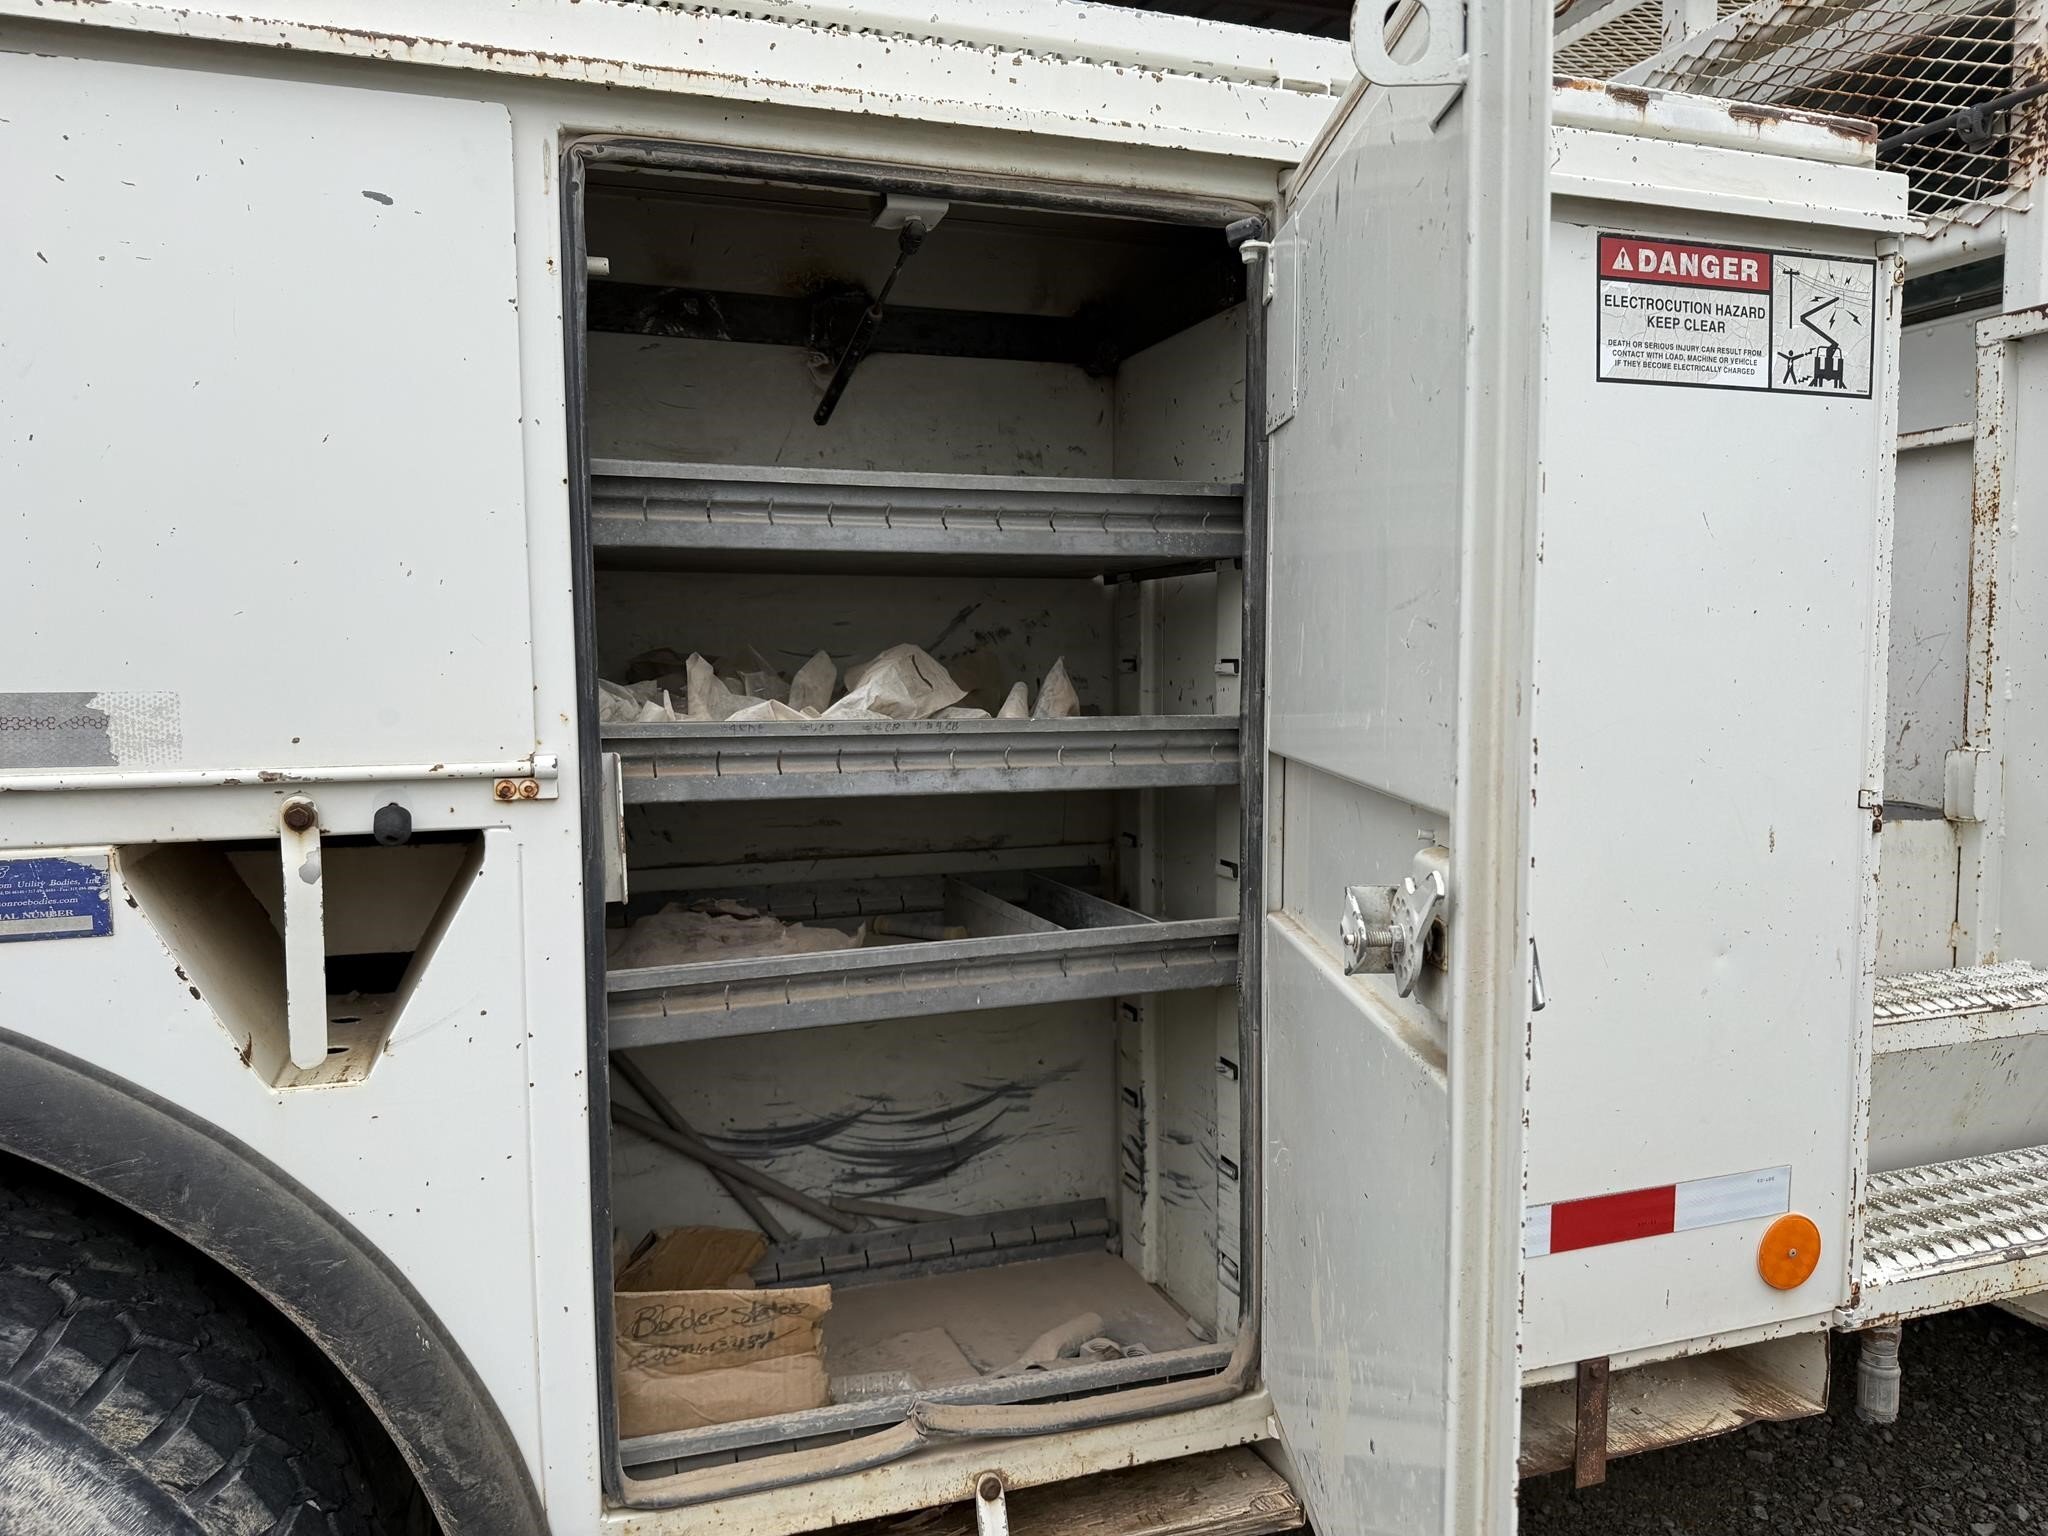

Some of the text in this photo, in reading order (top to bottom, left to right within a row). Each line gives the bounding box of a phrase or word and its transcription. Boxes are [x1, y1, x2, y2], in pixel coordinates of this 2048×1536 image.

[1638, 248, 1759, 282] DANGER
[1604, 294, 1766, 319] ELECTROCUTION HAZARD
[1647, 316, 1726, 333] KEEP CLEAR
[1607, 339, 1762, 357] DEATH OR SERIOUS INJURY CAN RESULT FROM
[1612, 349, 1758, 366] CONTACT WITH LOAD, MACHINE OR VEHICLE
[1614, 359, 1756, 375] IF THEY BECOME ELECTRICALLY CHARGED
[17, 880, 46, 889] Utility
[49, 878, 81, 887] Bodies,
[0, 897, 79, 908] onroebodies.com
[22, 909, 74, 919] NUMBER
[630, 1303, 729, 1339] Border
